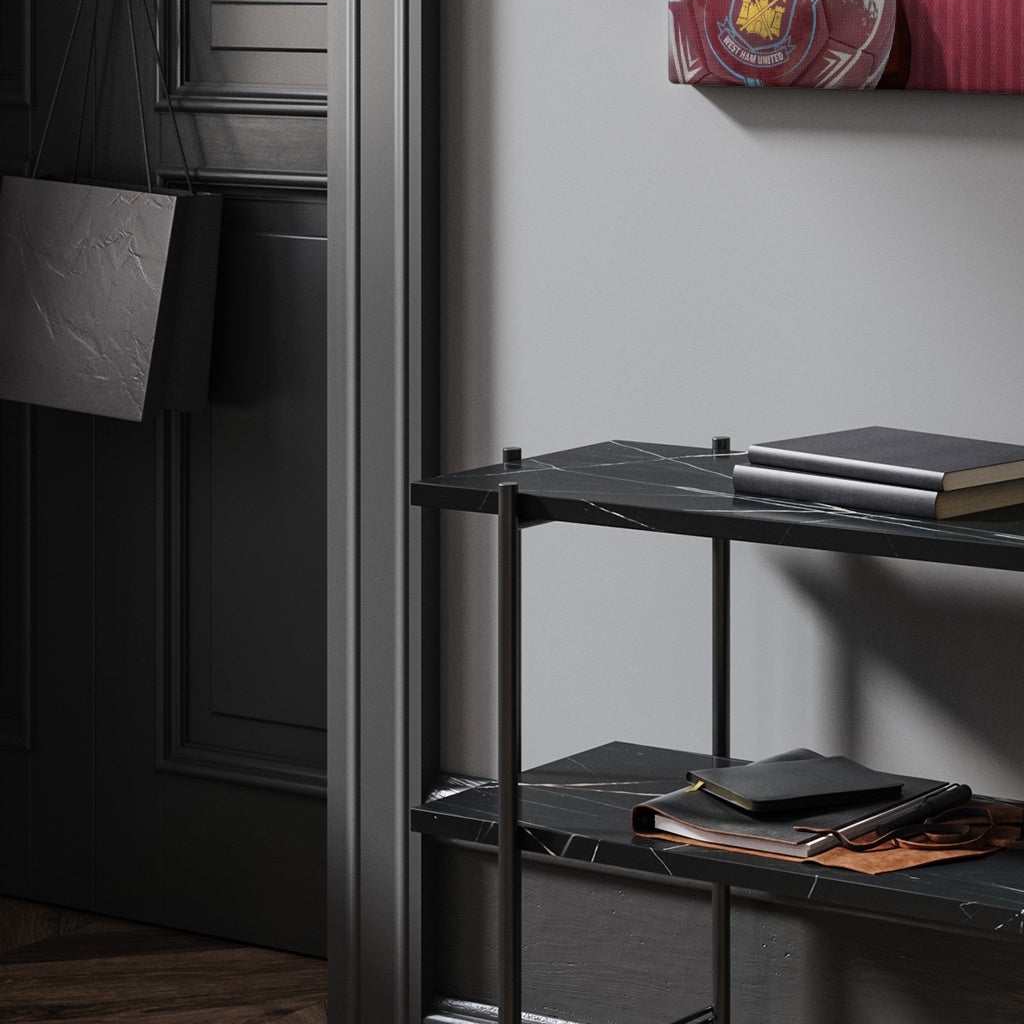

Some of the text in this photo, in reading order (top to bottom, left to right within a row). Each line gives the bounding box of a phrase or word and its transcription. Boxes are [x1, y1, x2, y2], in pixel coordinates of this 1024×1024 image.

[723, 35, 784, 65] WEST HAM UNITED
